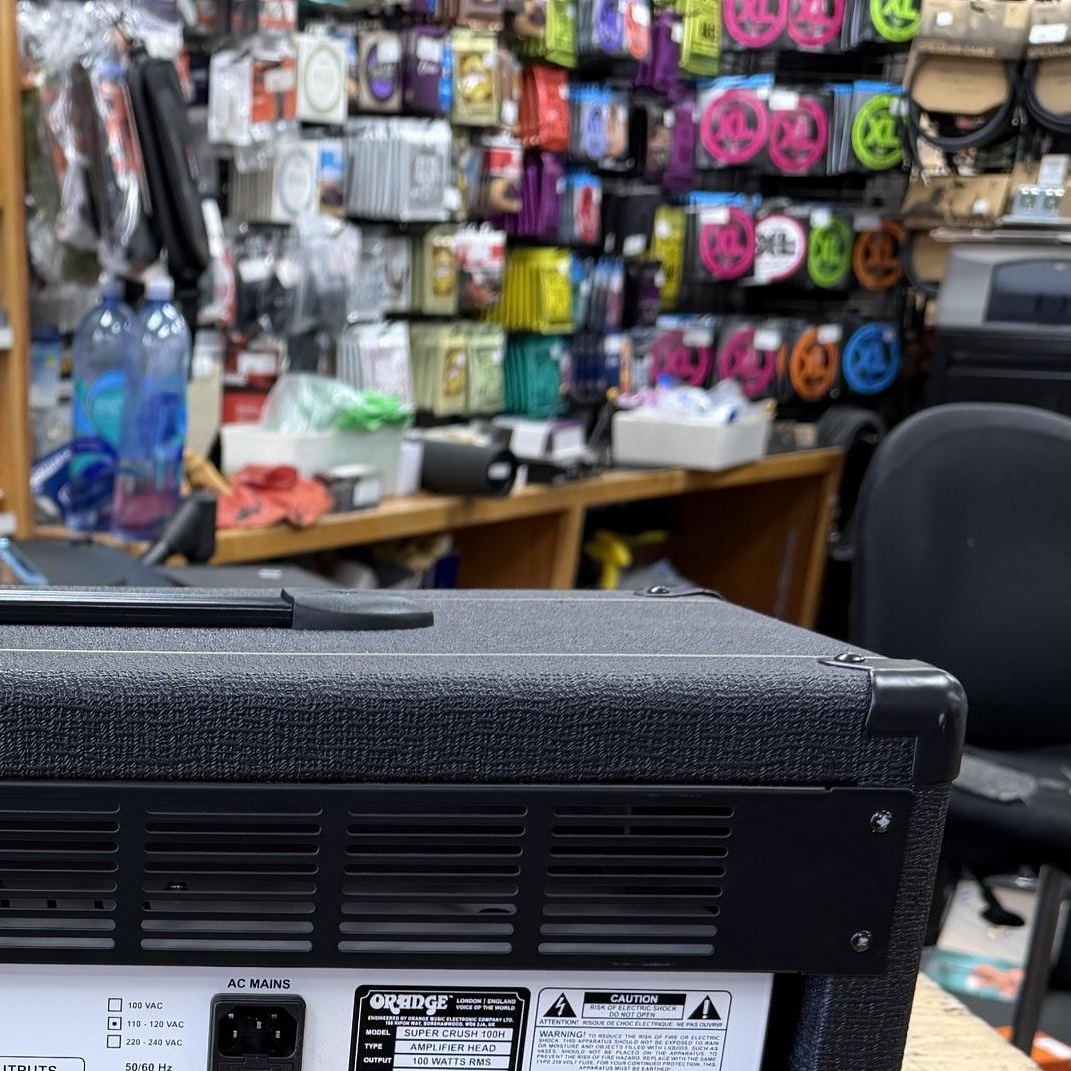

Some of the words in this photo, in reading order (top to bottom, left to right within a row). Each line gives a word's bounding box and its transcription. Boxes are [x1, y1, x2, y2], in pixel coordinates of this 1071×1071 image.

[714, 107, 755, 140] XL
[227, 978, 245, 989] AC
[250, 979, 291, 989] MAINS
[610, 994, 658, 1004] CAUTION
[145, 1002, 163, 1010] VAC
[370, 993, 449, 1016] ORANGE
[404, 1029, 439, 1037] SUPER
[442, 1030, 478, 1038] CRUSH
[410, 1043, 465, 1052] AMPLIFIER
[468, 1044, 496, 1052] HEAD
[413, 1057, 429, 1065] 100
[432, 1057, 466, 1066] WATTS
[469, 1058, 491, 1066] RMS
[125, 1063, 154, 1071] 50/60
[159, 1063, 173, 1071] Hz
